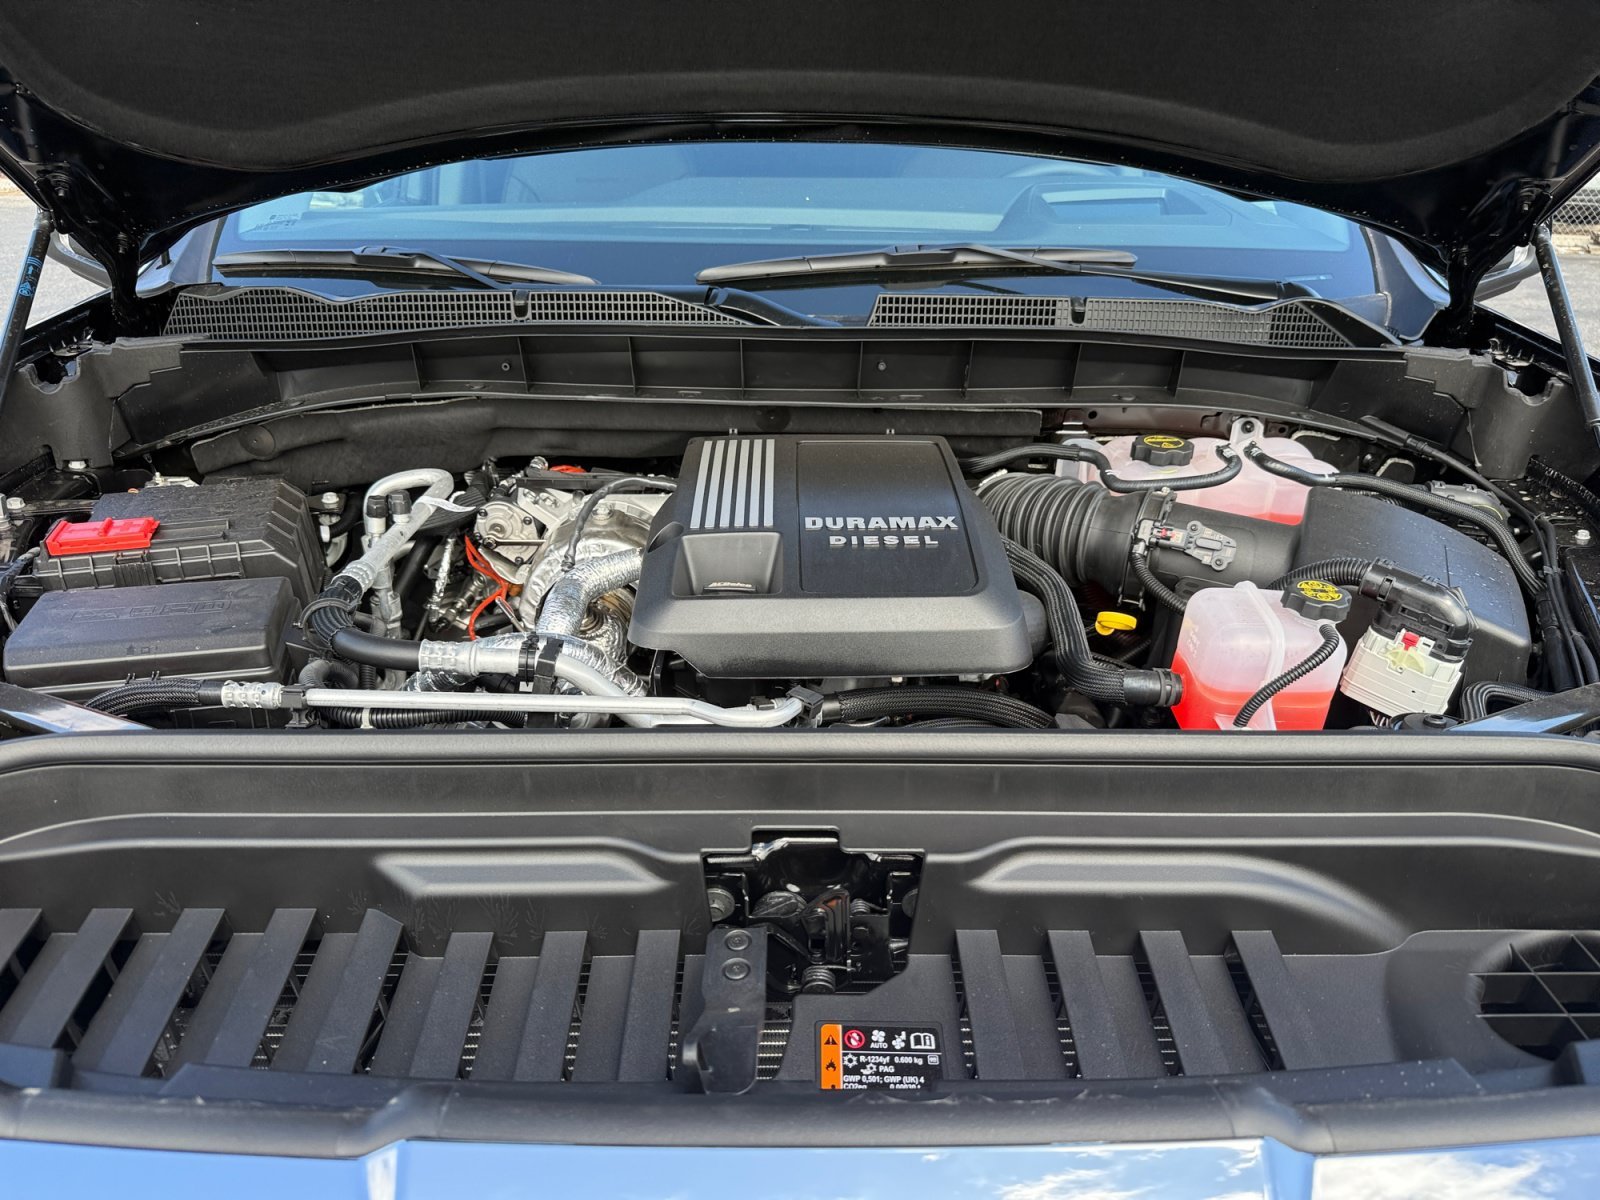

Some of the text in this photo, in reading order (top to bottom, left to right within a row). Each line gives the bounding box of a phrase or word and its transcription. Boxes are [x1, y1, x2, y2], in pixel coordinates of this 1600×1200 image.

[804, 516, 958, 530] DURAMAX
[829, 535, 938, 546] DIESEL
[860, 1056, 890, 1064] R-1234yf
[913, 1056, 923, 1065] kg
[879, 1065, 895, 1073] PAG
[902, 1076, 918, 1084] (UK)
